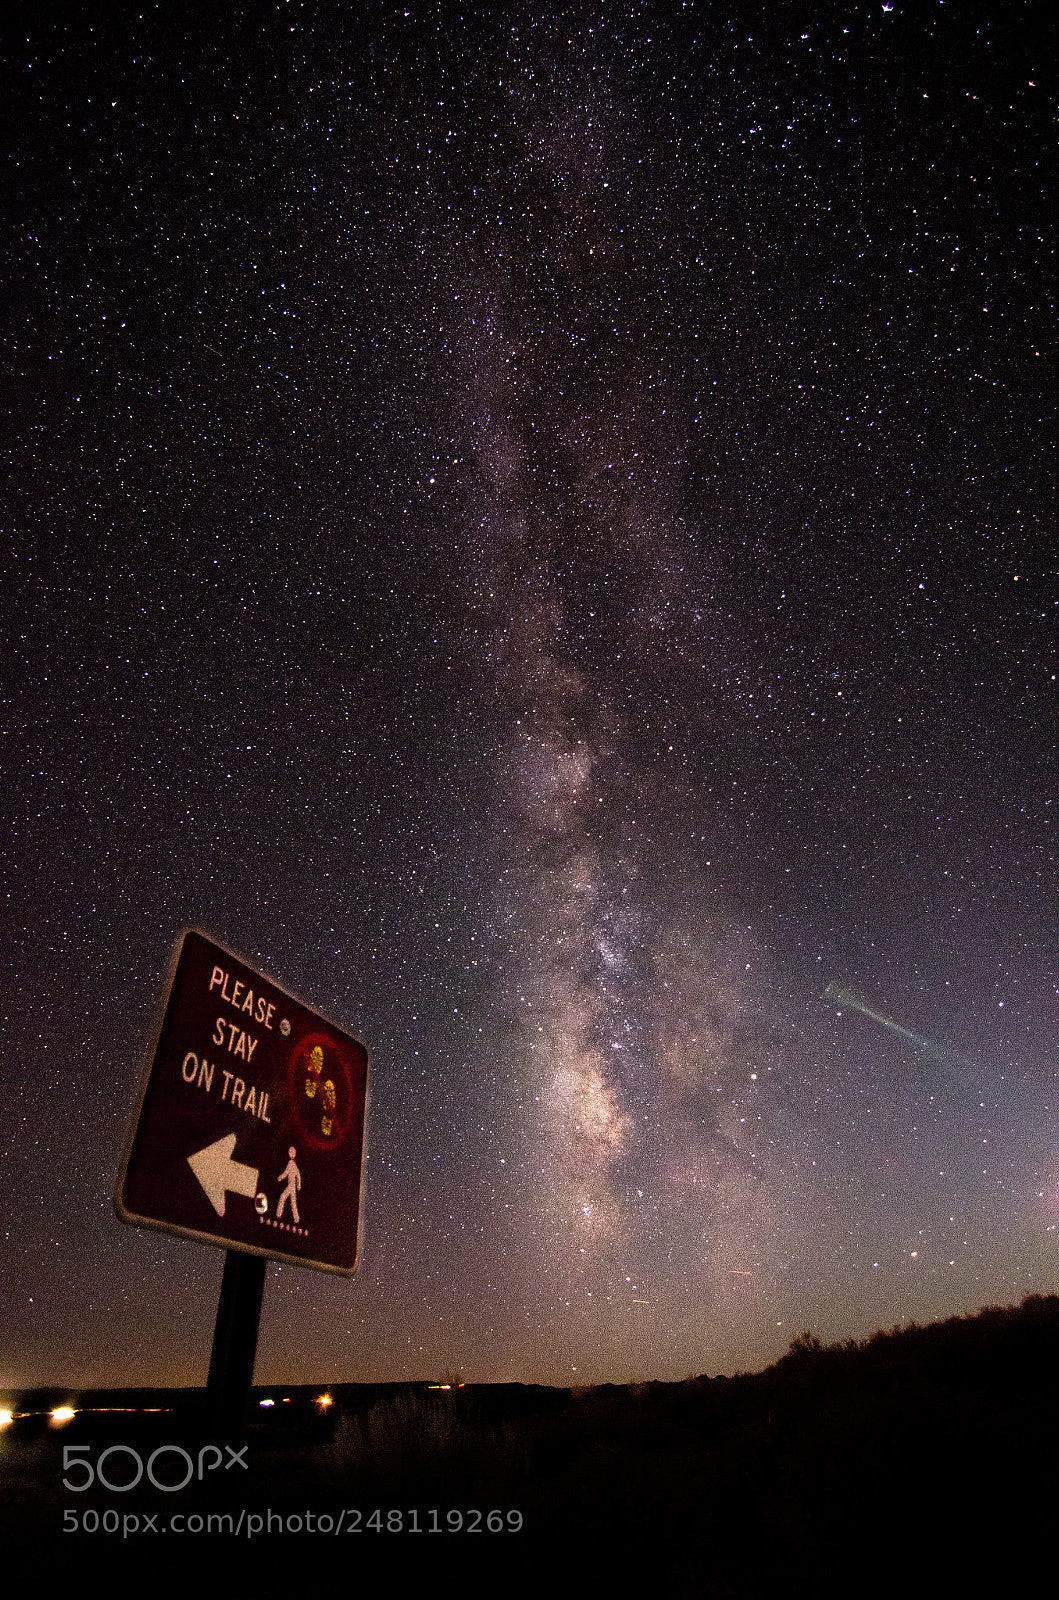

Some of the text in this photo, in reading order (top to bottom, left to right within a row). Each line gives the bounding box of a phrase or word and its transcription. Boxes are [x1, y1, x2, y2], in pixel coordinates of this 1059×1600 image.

[209, 965, 276, 1031] PLEASE
[212, 1017, 258, 1063] STAY
[182, 1052, 271, 1124] ON TRAIL
